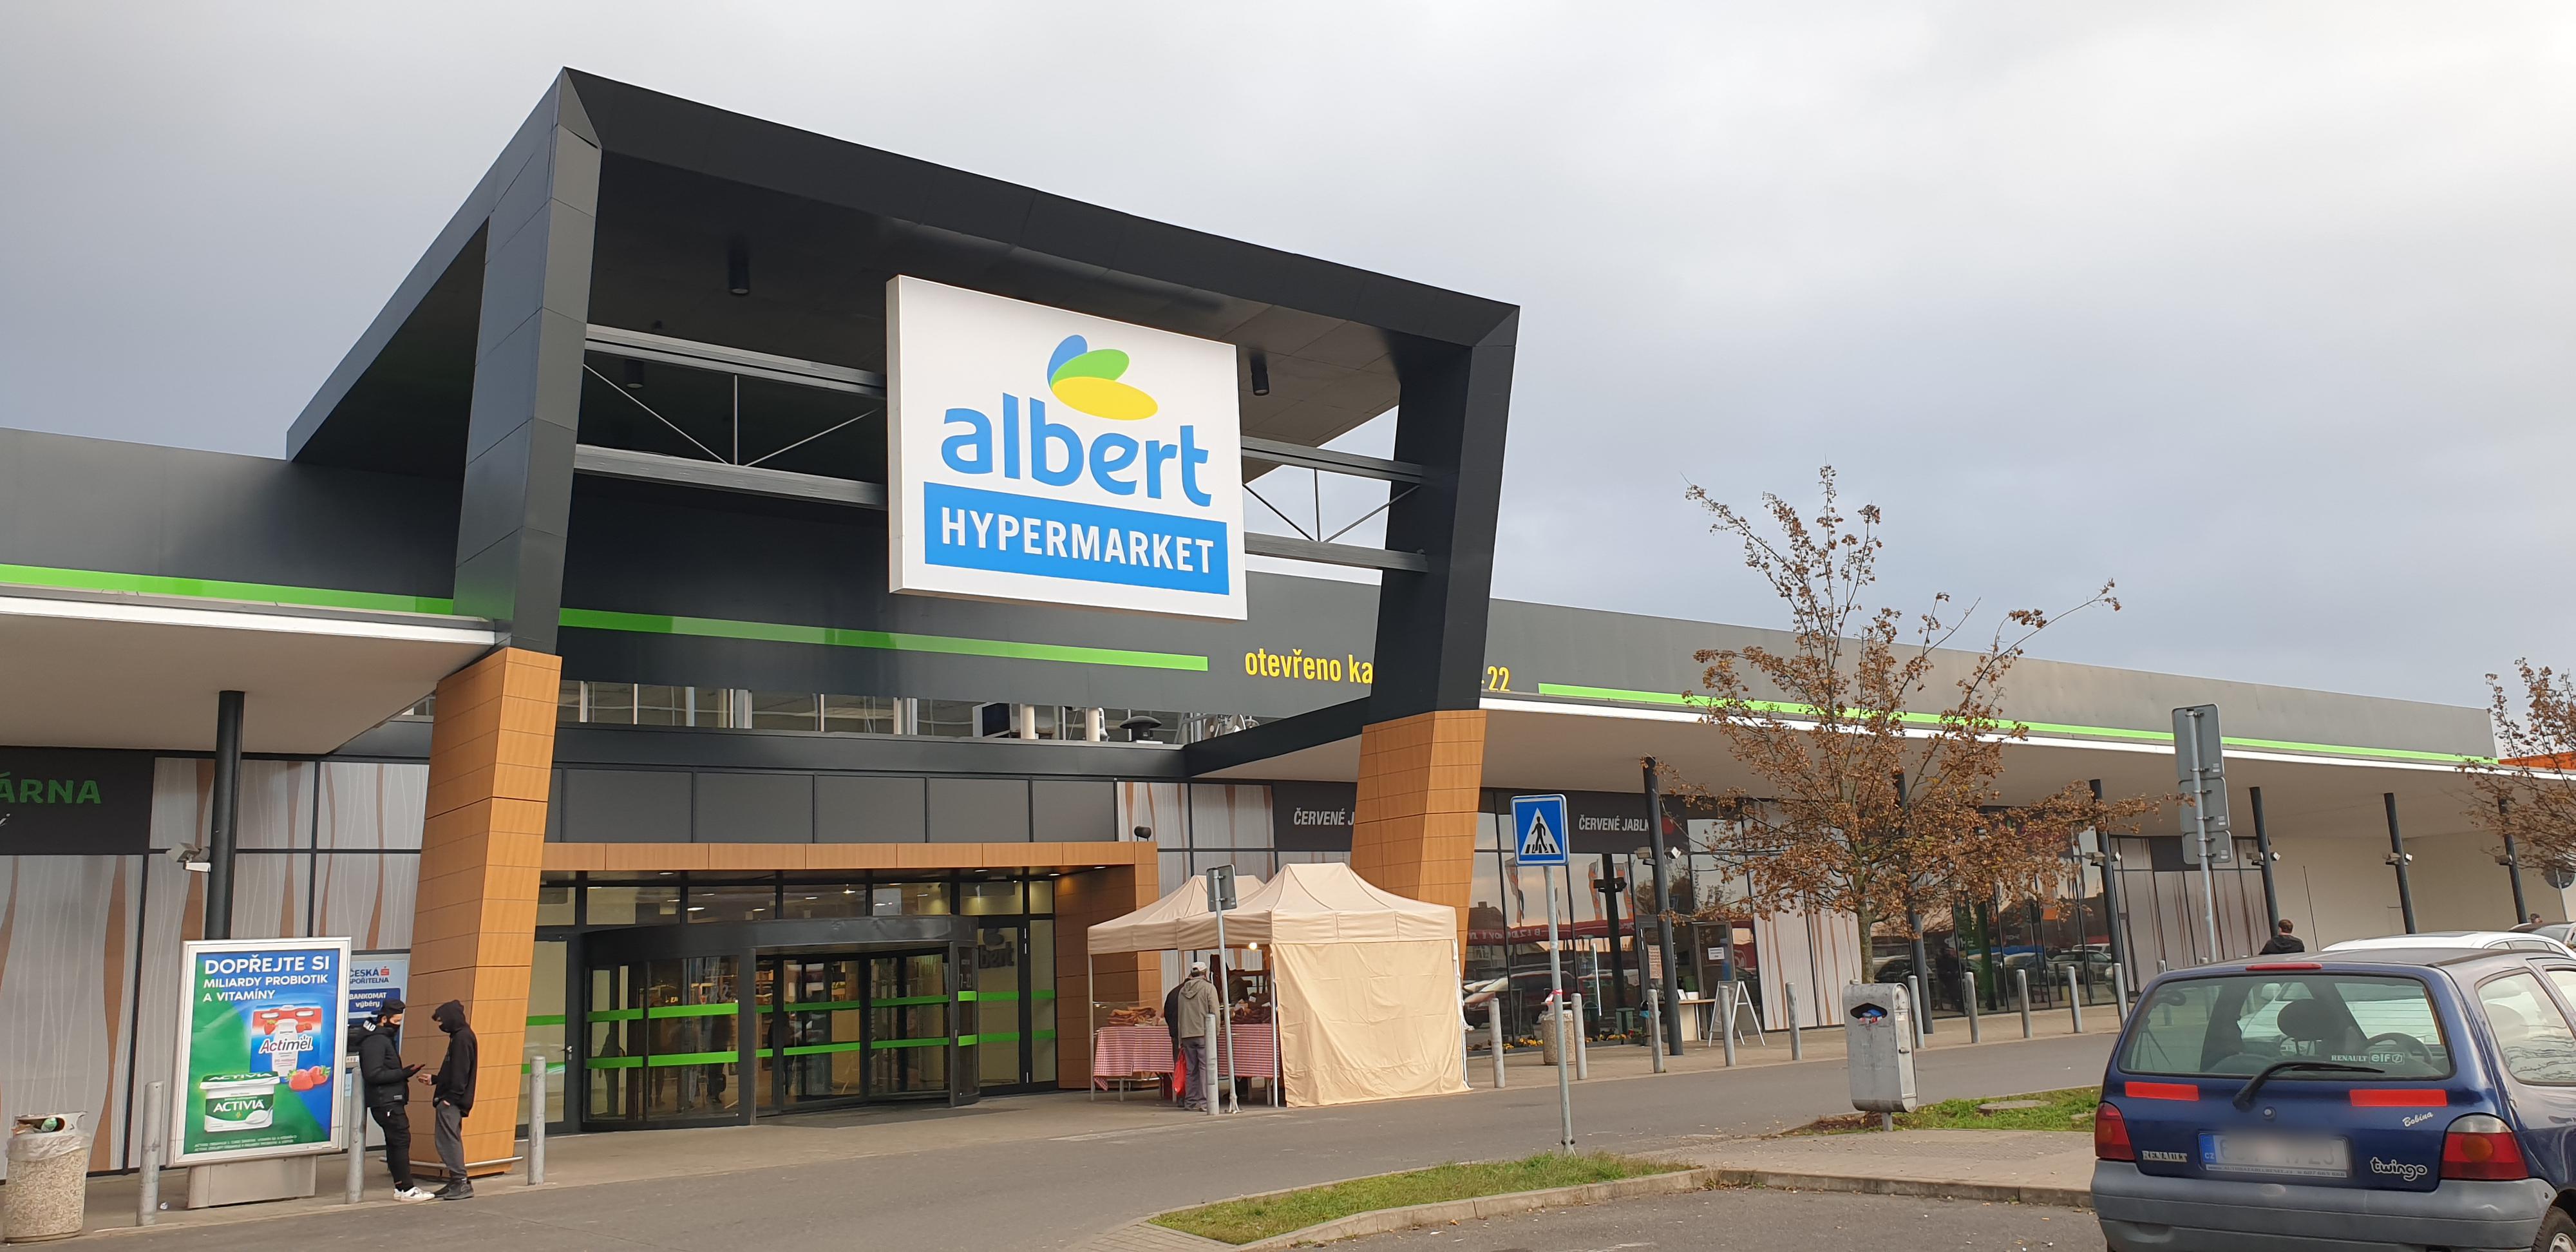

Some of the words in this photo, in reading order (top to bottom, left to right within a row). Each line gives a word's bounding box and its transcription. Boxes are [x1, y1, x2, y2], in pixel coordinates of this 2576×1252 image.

[941, 392, 1212, 507] albert
[942, 506, 1214, 574] HYPERMARKET
[1244, 647, 1342, 682] otevřeno
[1348, 653, 1373, 685] ka
[0, 772, 102, 804] ÁRNA
[1293, 807, 1345, 826] ČERVENÉ
[1578, 814, 1620, 831] ČERVENÉ
[204, 954, 305, 974] DOPŘEJTE
[311, 956, 330, 971] SI
[204, 977, 263, 989] MILIARDY
[265, 974, 328, 986] PROBIOTIK
[202, 993, 213, 1003] A
[216, 988, 276, 1001] VITAMÍNY
[260, 1035, 312, 1052] Actimel
[2371, 1054, 2391, 1063] elf
[208, 1073, 272, 1081] ACTIVIA
[213, 1099, 265, 1113] ACTIVIA
[2142, 1150, 2188, 1162] RENAULT
[2370, 1157, 2428, 1181] twingo
